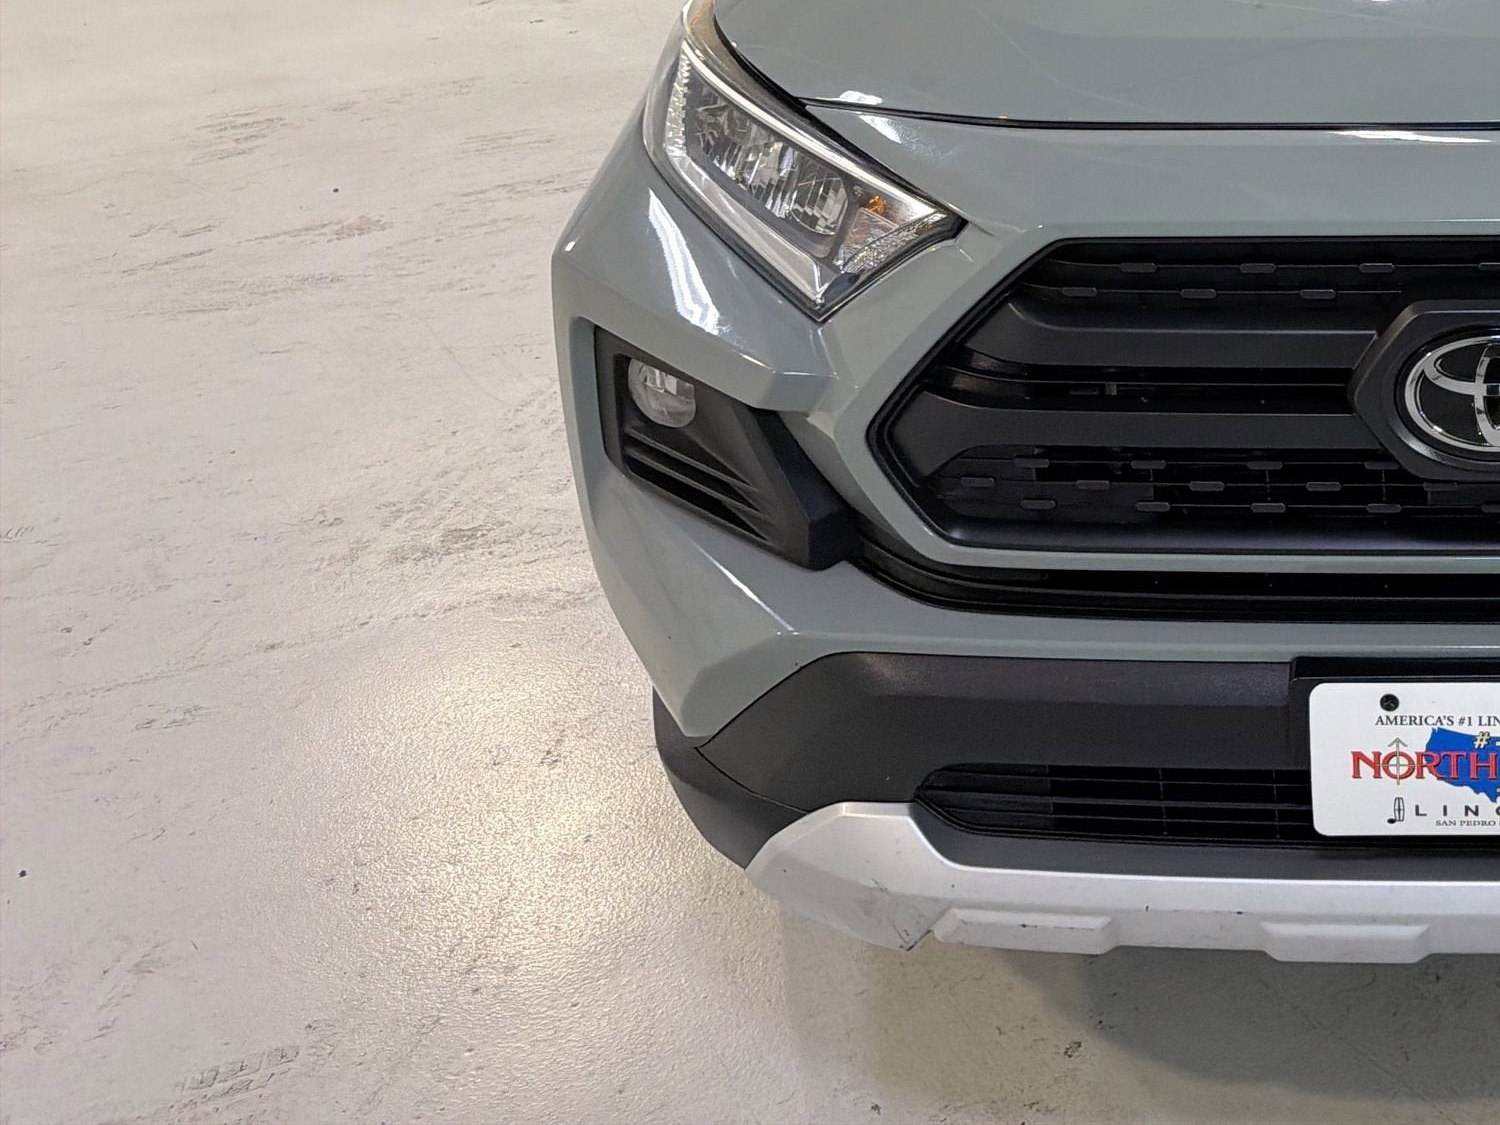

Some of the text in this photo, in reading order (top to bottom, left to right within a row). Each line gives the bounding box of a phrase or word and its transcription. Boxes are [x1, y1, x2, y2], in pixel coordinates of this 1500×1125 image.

[1375, 715, 1454, 726] AMERICA'S
[1458, 715, 1473, 727] #1
[1351, 751, 1498, 780] NORTH
[1435, 819, 1457, 827] SAN
[1460, 819, 1497, 827] PEDRO
